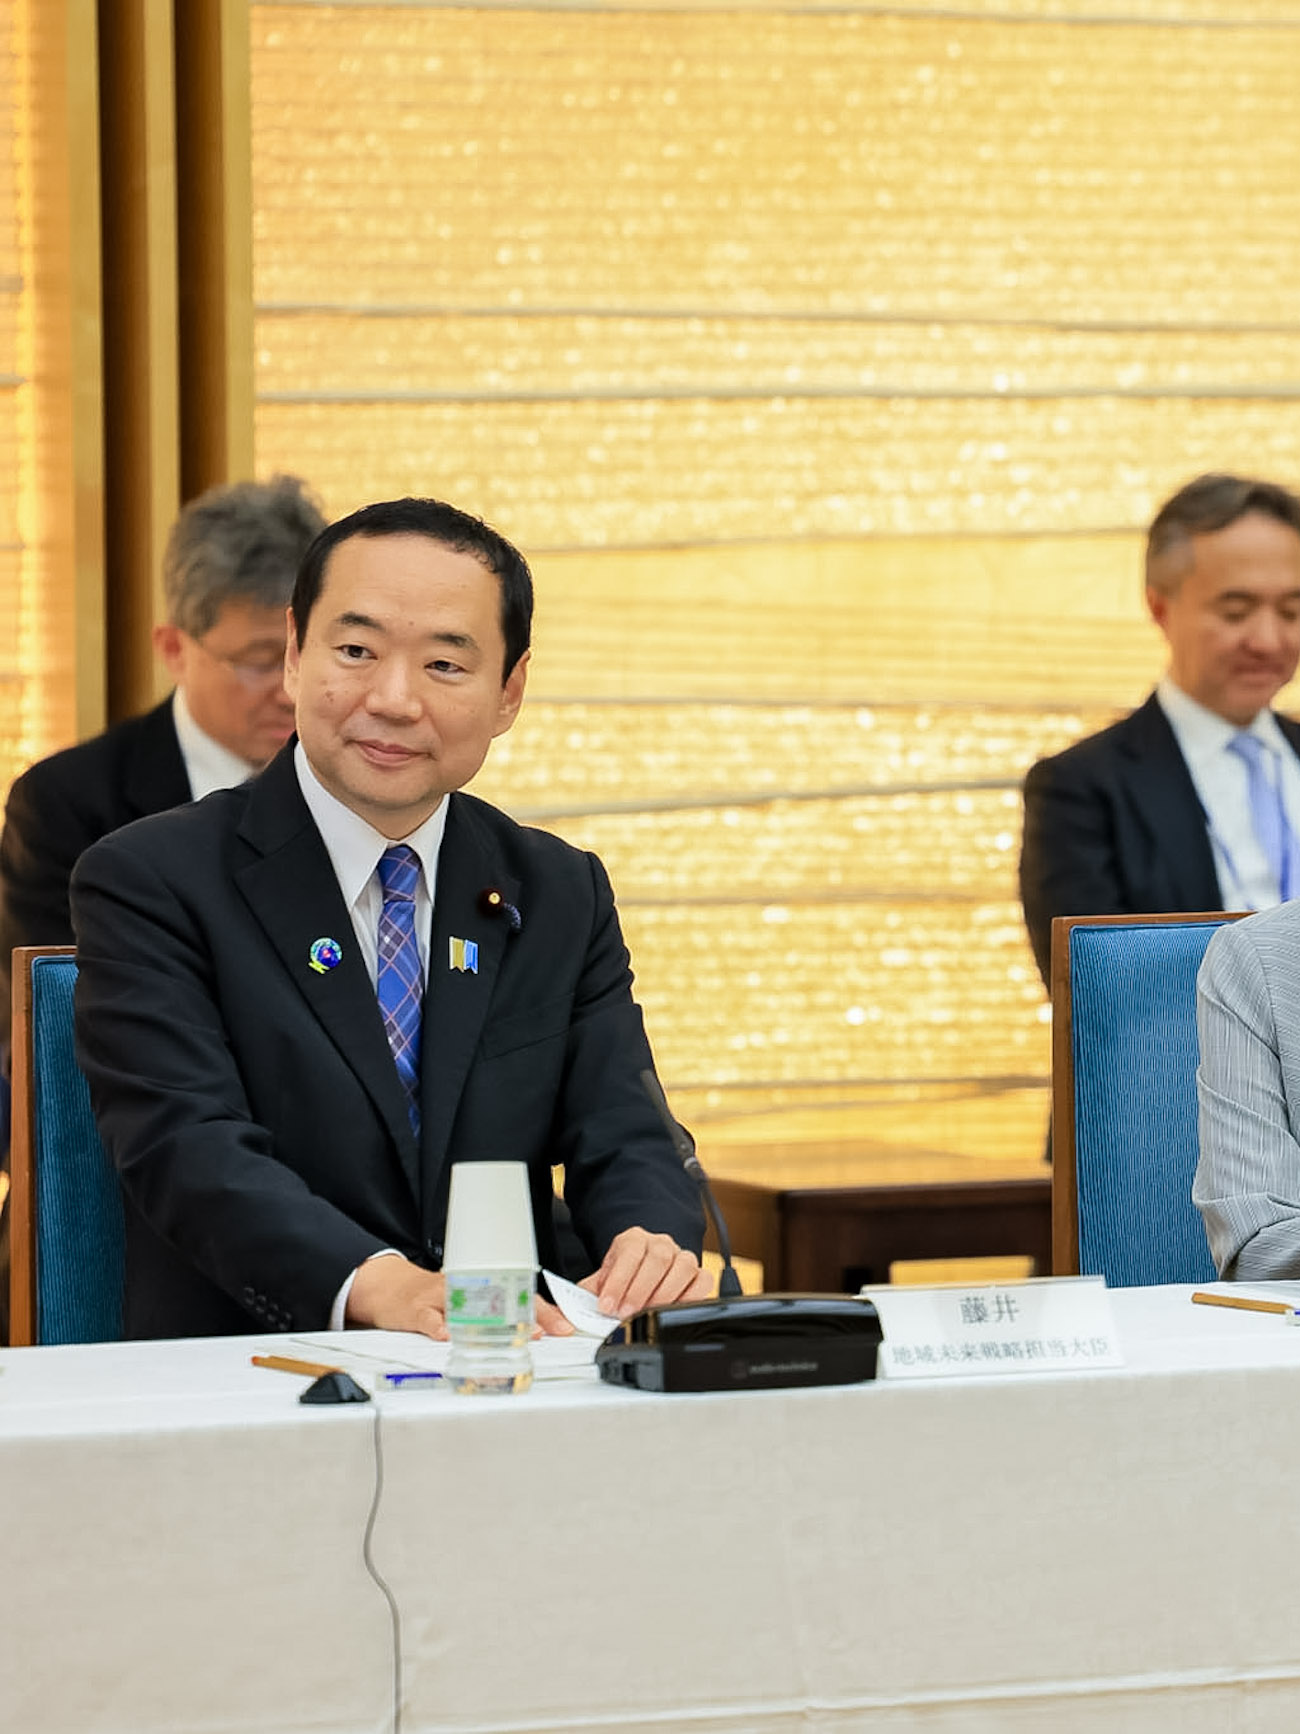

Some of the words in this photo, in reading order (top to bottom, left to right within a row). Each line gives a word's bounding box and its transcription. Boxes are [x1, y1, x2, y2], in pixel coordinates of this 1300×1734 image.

[960, 1294, 1019, 1324] 藤井
[892, 1335, 1109, 1366] 地域未来戦略担当大臣
